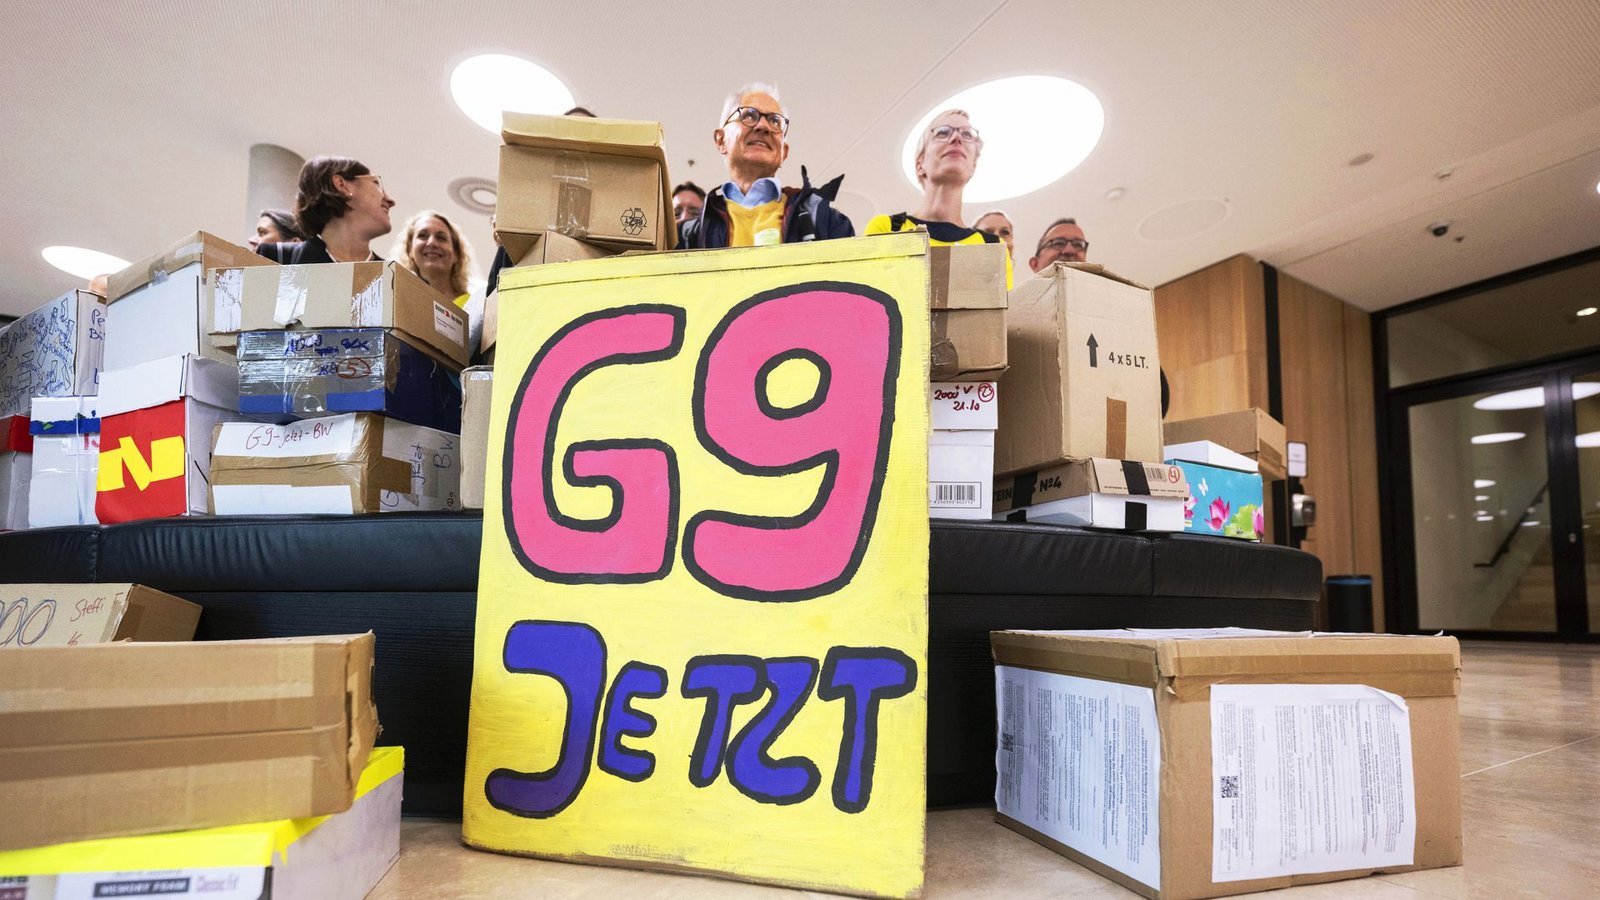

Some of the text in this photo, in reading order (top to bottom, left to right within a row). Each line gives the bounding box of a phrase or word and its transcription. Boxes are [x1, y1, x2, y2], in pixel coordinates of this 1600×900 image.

[1134, 355, 1149, 369] LT.
[502, 280, 903, 603] G9
[70, 597, 106, 622] Steffi
[484, 620, 918, 819] JETZT
